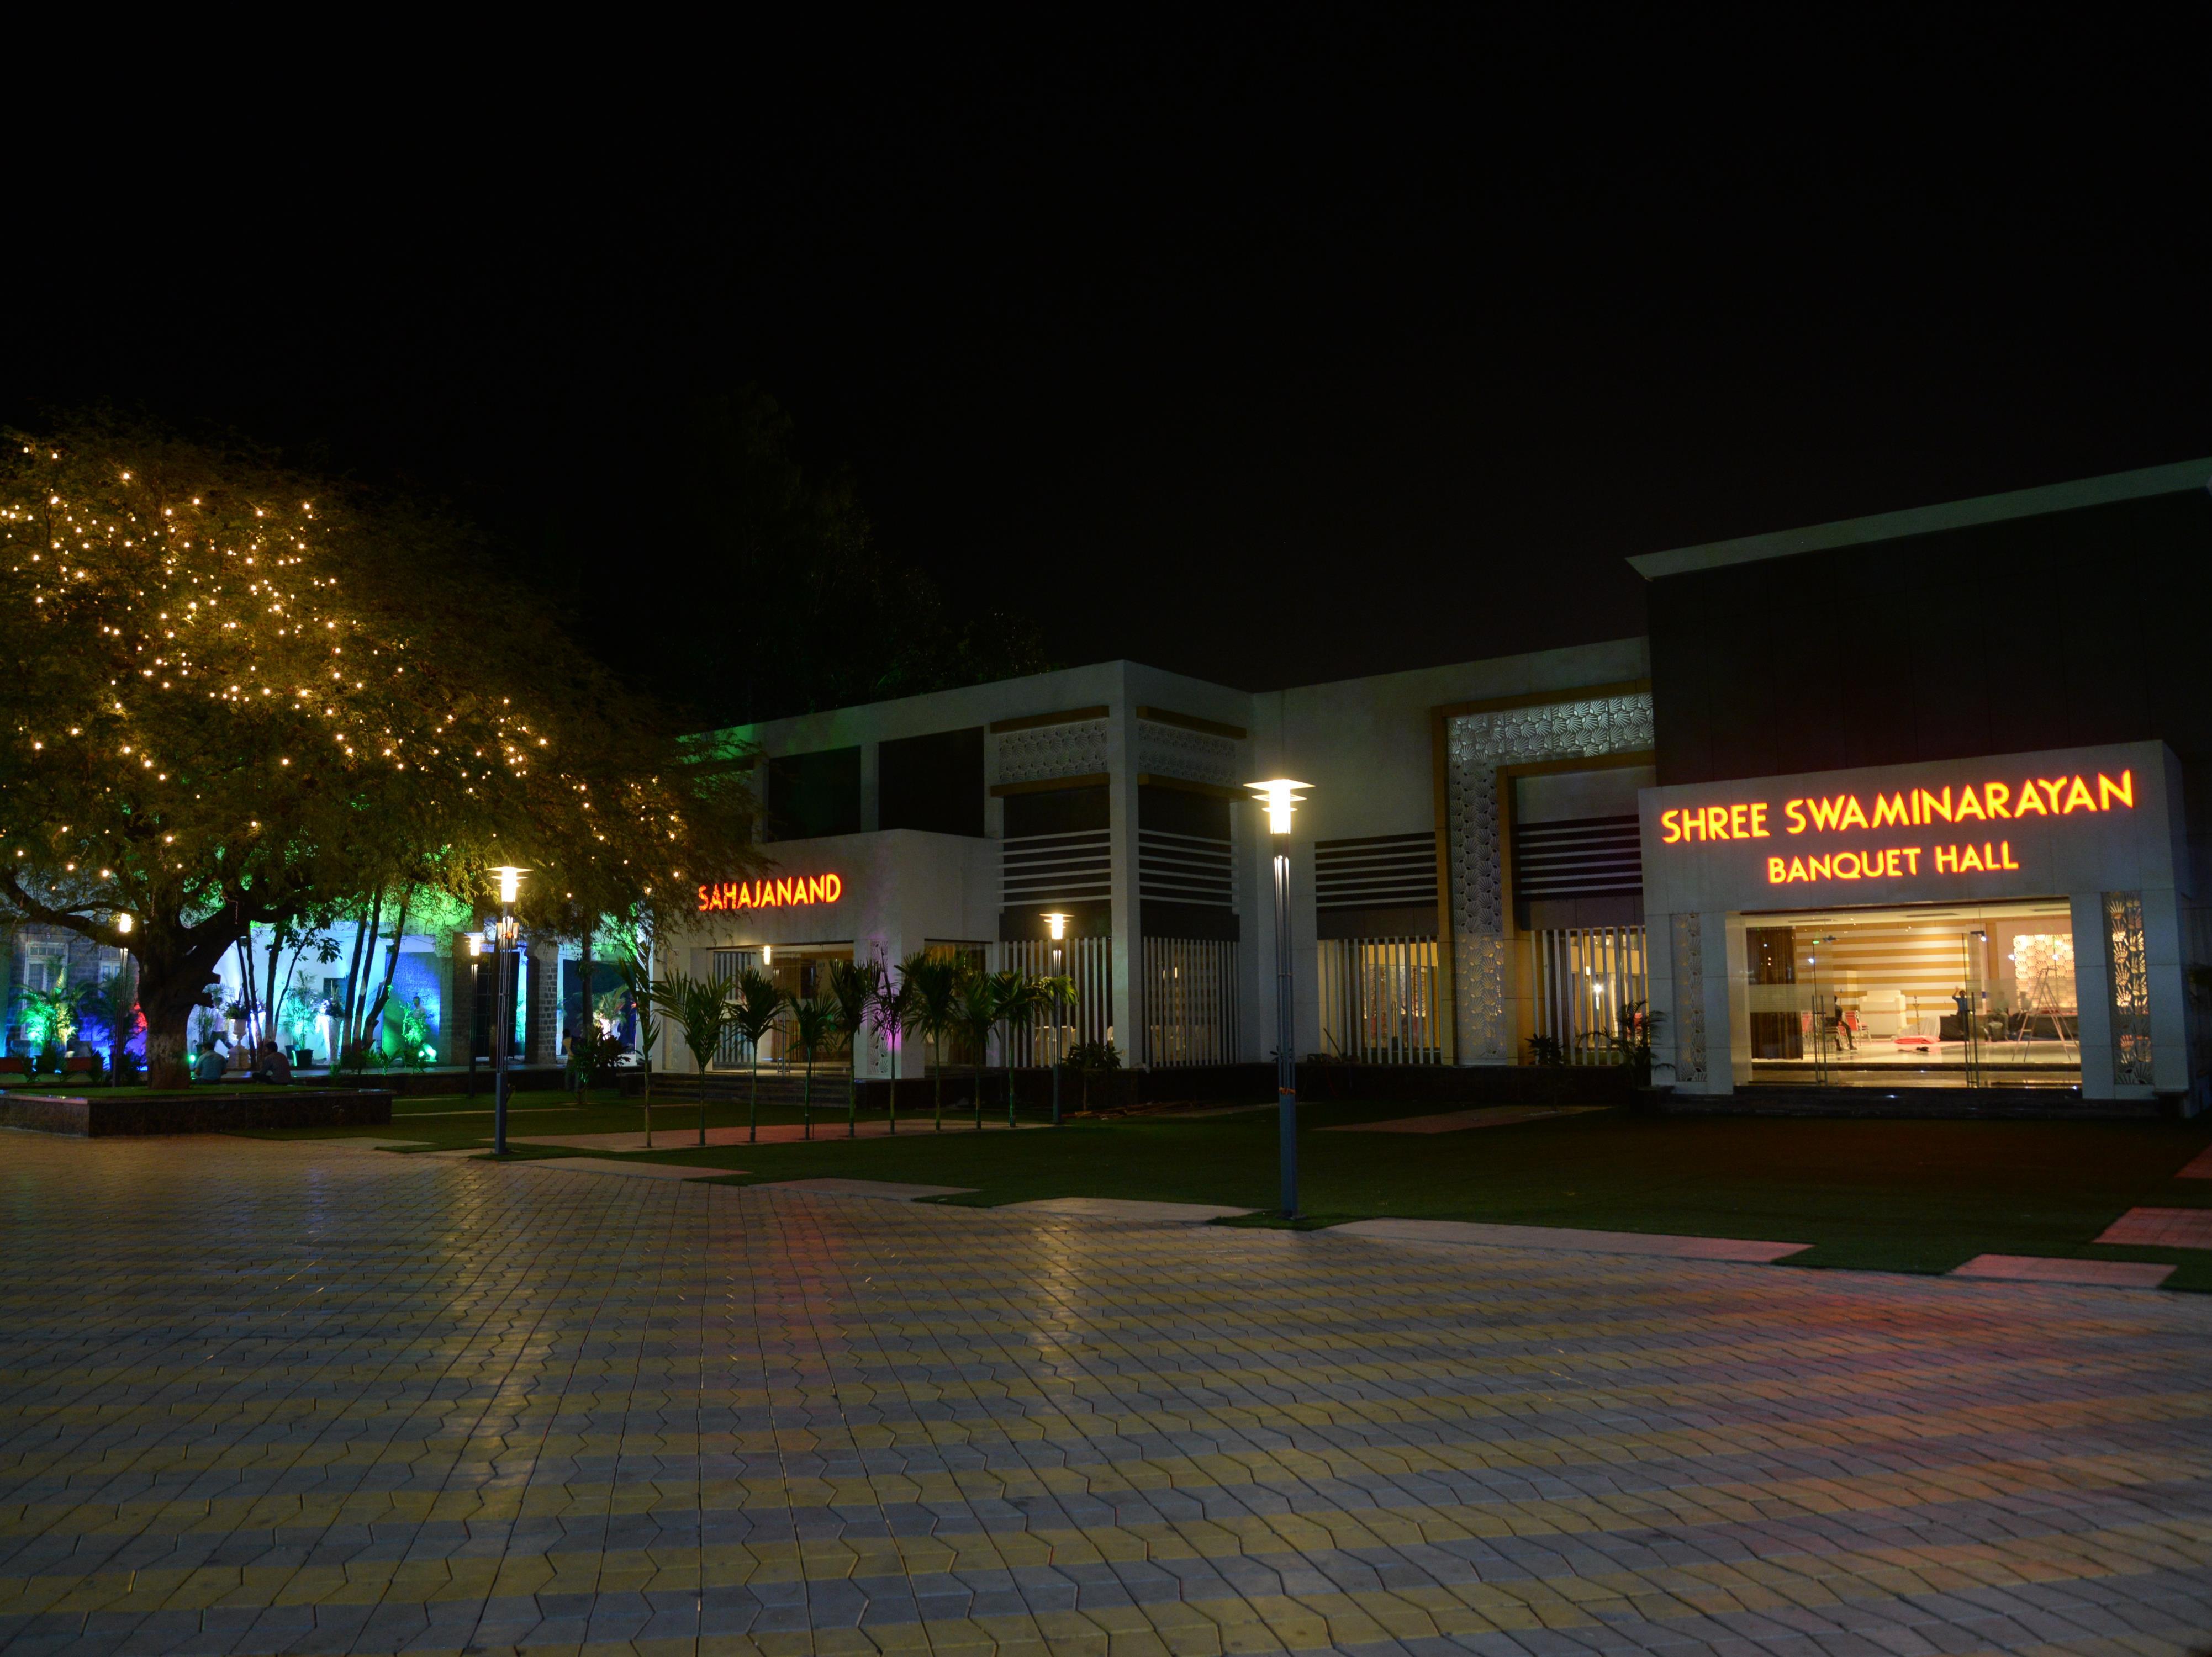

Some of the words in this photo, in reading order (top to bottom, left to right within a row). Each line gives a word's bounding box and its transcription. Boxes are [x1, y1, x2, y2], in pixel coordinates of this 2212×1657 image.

[1660, 802, 1771, 845] SHREE
[1784, 769, 2134, 835] SWAMINARAYAN
[1767, 846, 1921, 885] BANQUET
[1934, 840, 2020, 874] HALL
[698, 873, 841, 911] SAHAJANAND
